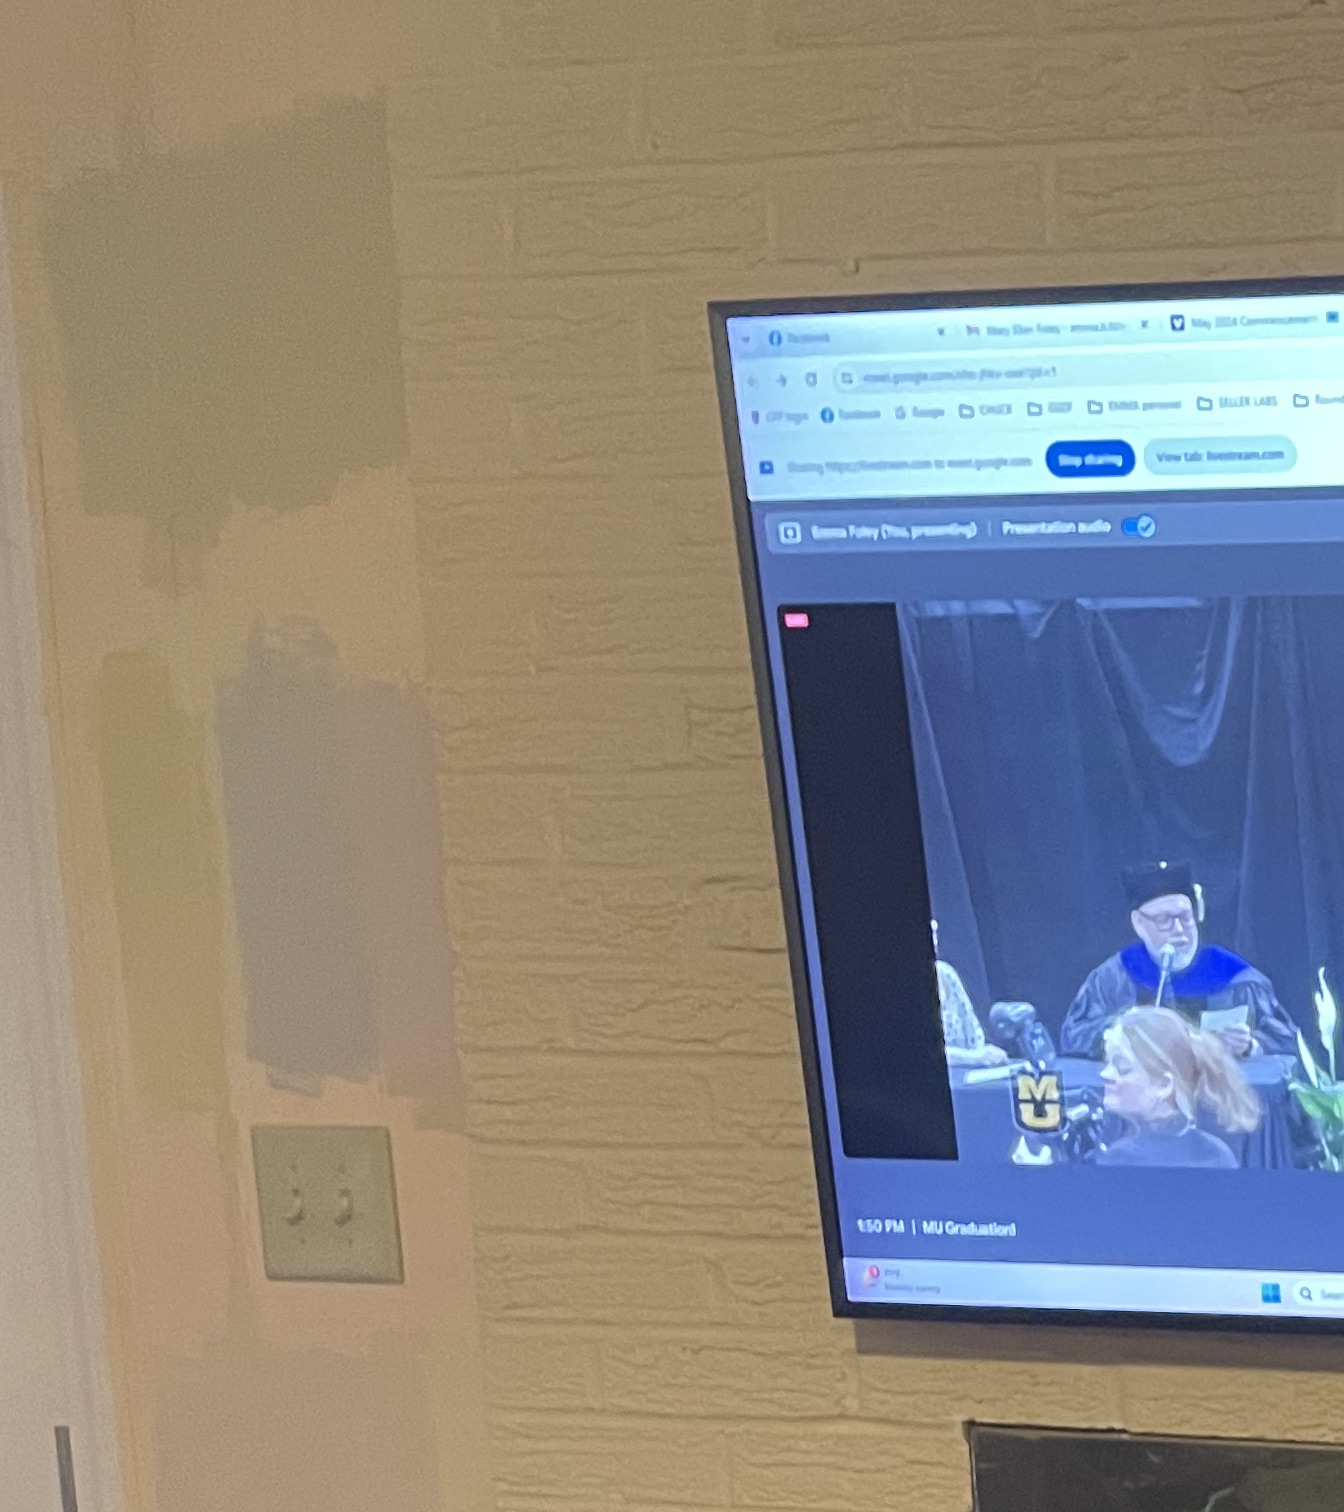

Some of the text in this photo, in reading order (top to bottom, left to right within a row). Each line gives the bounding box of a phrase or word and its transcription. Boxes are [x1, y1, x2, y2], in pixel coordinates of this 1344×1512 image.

[1058, 454, 1083, 468] Stop
[1156, 453, 1182, 462] View
[1002, 517, 1112, 536] Presentation audio
[1017, 1075, 1060, 1129] MU
[884, 1219, 905, 1234] PM
[922, 1220, 943, 1236] MU
